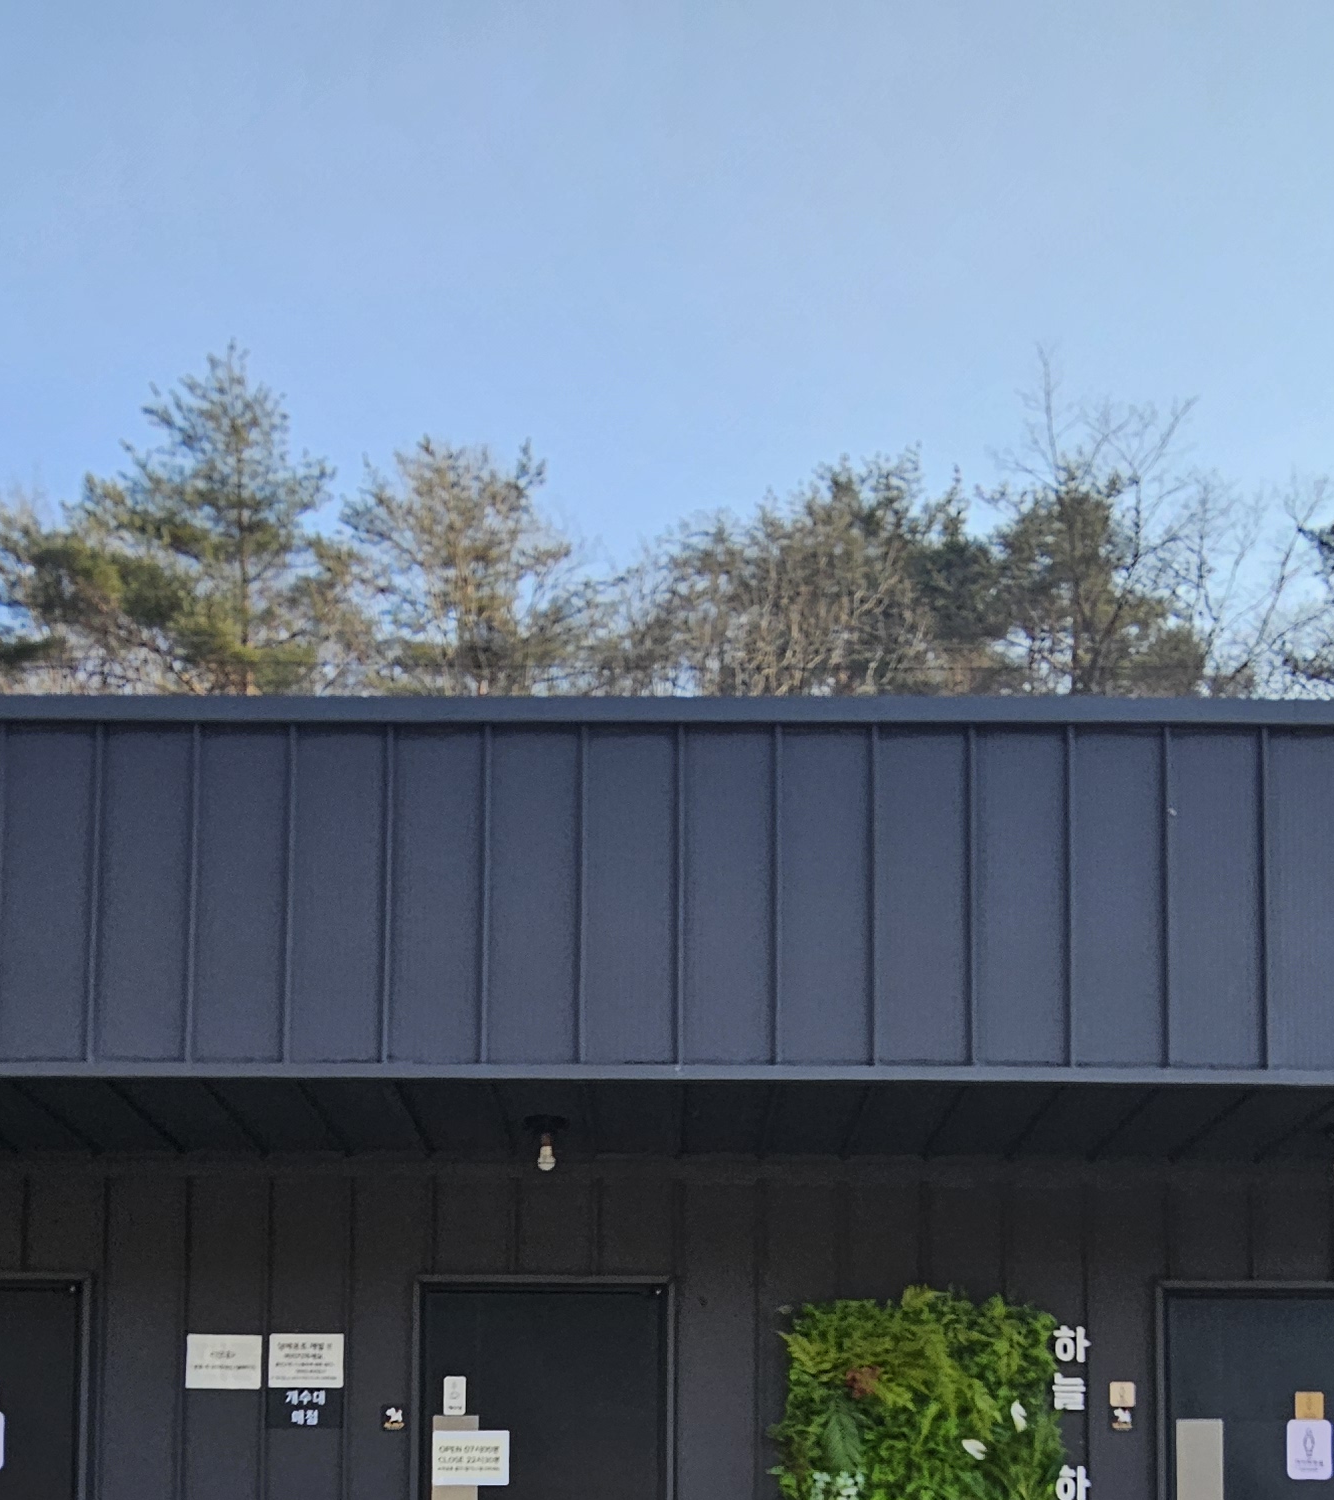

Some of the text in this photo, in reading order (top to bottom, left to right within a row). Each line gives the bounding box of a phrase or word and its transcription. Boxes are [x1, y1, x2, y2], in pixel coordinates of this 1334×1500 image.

[1053, 1325, 1092, 1411] 하늘
[284, 1389, 327, 1406] 개수대
[290, 1409, 319, 1426] 매점
[438, 1445, 462, 1454] OPEN
[437, 1456, 464, 1464] CLOSE
